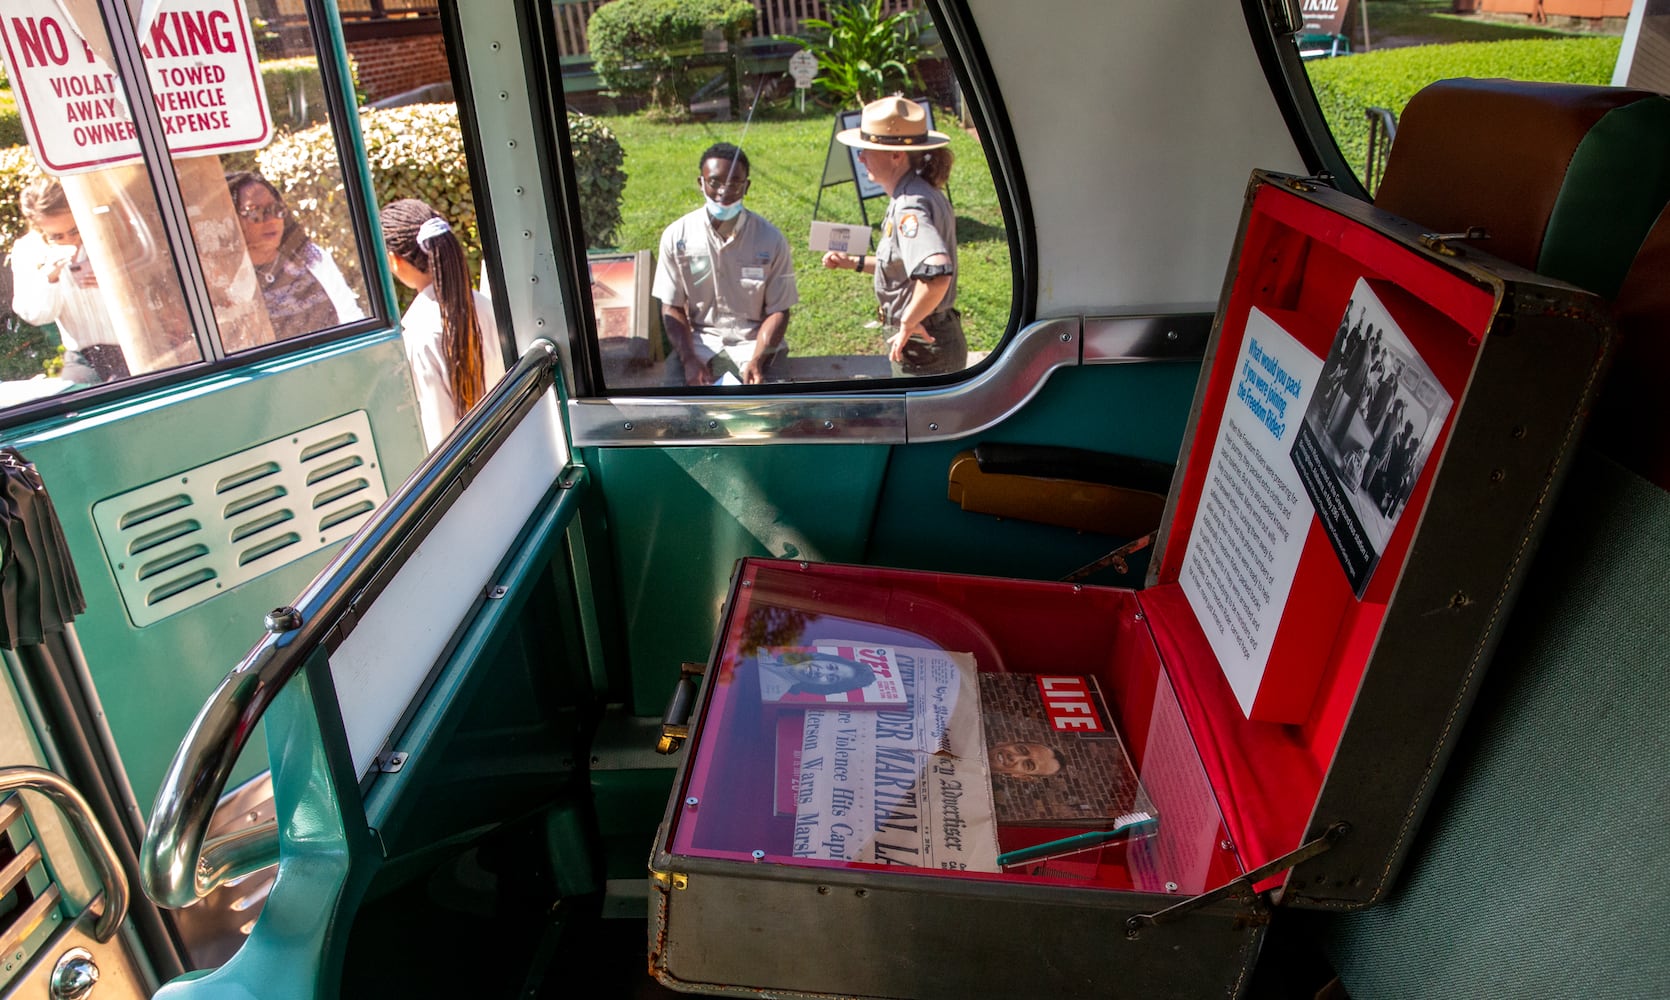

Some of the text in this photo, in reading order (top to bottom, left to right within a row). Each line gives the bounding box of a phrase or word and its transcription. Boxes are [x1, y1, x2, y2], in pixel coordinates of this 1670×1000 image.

[11, 10, 237, 68] NO KING
[49, 65, 225, 98] VIOLAT TOWED
[66, 88, 226, 123] AWAY VEHICLE
[73, 110, 231, 147] OWNER XPENSE
[1242, 358, 1286, 418] if you were joining
[1248, 338, 1300, 398] What would you pack
[1237, 382, 1284, 439] the Freedom Rides?
[874, 694, 915, 741] DER
[1041, 677, 1097, 730] LIFE
[833, 728, 857, 782] Violence
[793, 709, 825, 858] tterson Warns Marsh
[830, 786, 855, 817] Hits
[874, 745, 919, 834] MARTIAL
[821, 823, 855, 861] Capi
[939, 778, 968, 852] Advertiser
